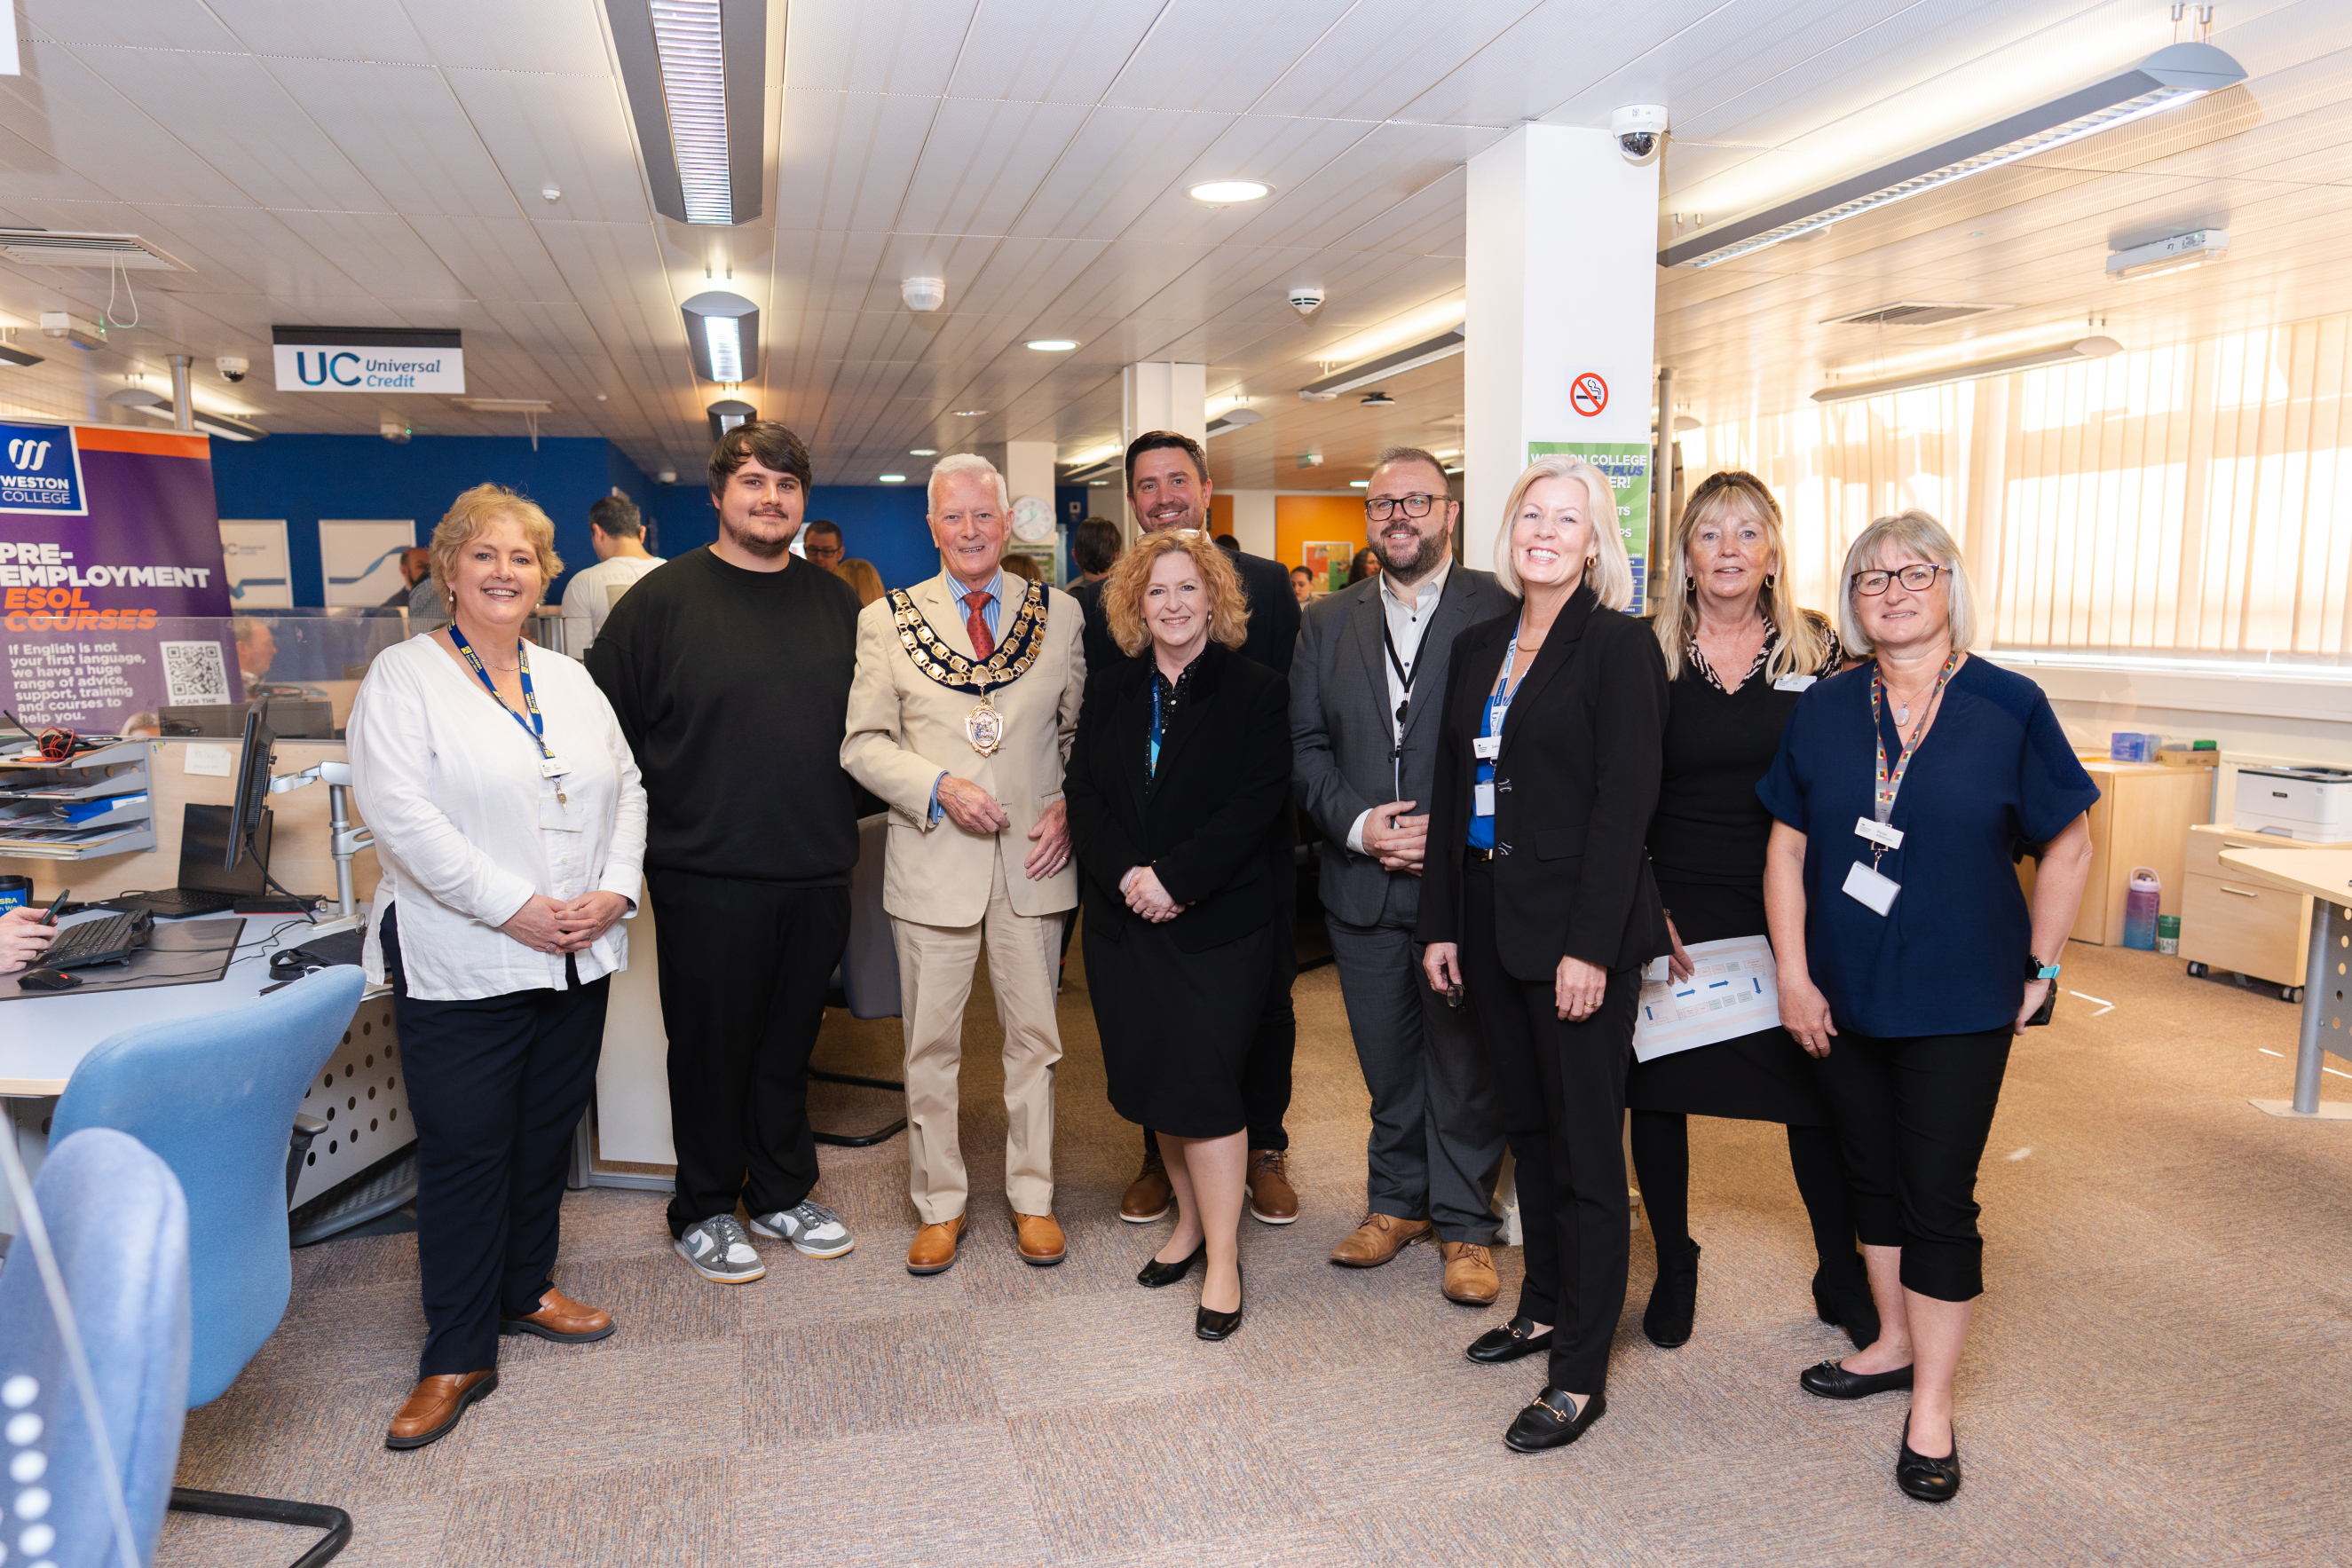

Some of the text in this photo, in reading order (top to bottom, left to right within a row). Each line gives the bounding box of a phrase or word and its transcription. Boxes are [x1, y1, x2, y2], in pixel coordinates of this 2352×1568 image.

[296, 351, 362, 386] UC
[366, 359, 441, 373] Universal
[367, 374, 415, 388] Credit
[1531, 453, 1648, 466] WON COLLEGE
[1612, 465, 1645, 477] PLUS
[0, 475, 69, 490] WESTON
[1607, 476, 1631, 489] ER!
[2, 490, 72, 504] COLLEGE
[1616, 506, 1631, 516] TS
[1620, 527, 1632, 538] PS
[0, 542, 74, 565] PRE-
[0, 564, 210, 588] EMPLOYMENT
[4, 587, 90, 610] ESOL
[4, 609, 158, 633] COURSES
[8, 642, 118, 658] If English is not
[10, 653, 146, 668] your first language,
[12, 664, 122, 679] we have a huge
[13, 674, 129, 690] range of advice,
[15, 685, 134, 702] support, training
[17, 697, 122, 713] and courses to
[19, 711, 86, 724] help you.
